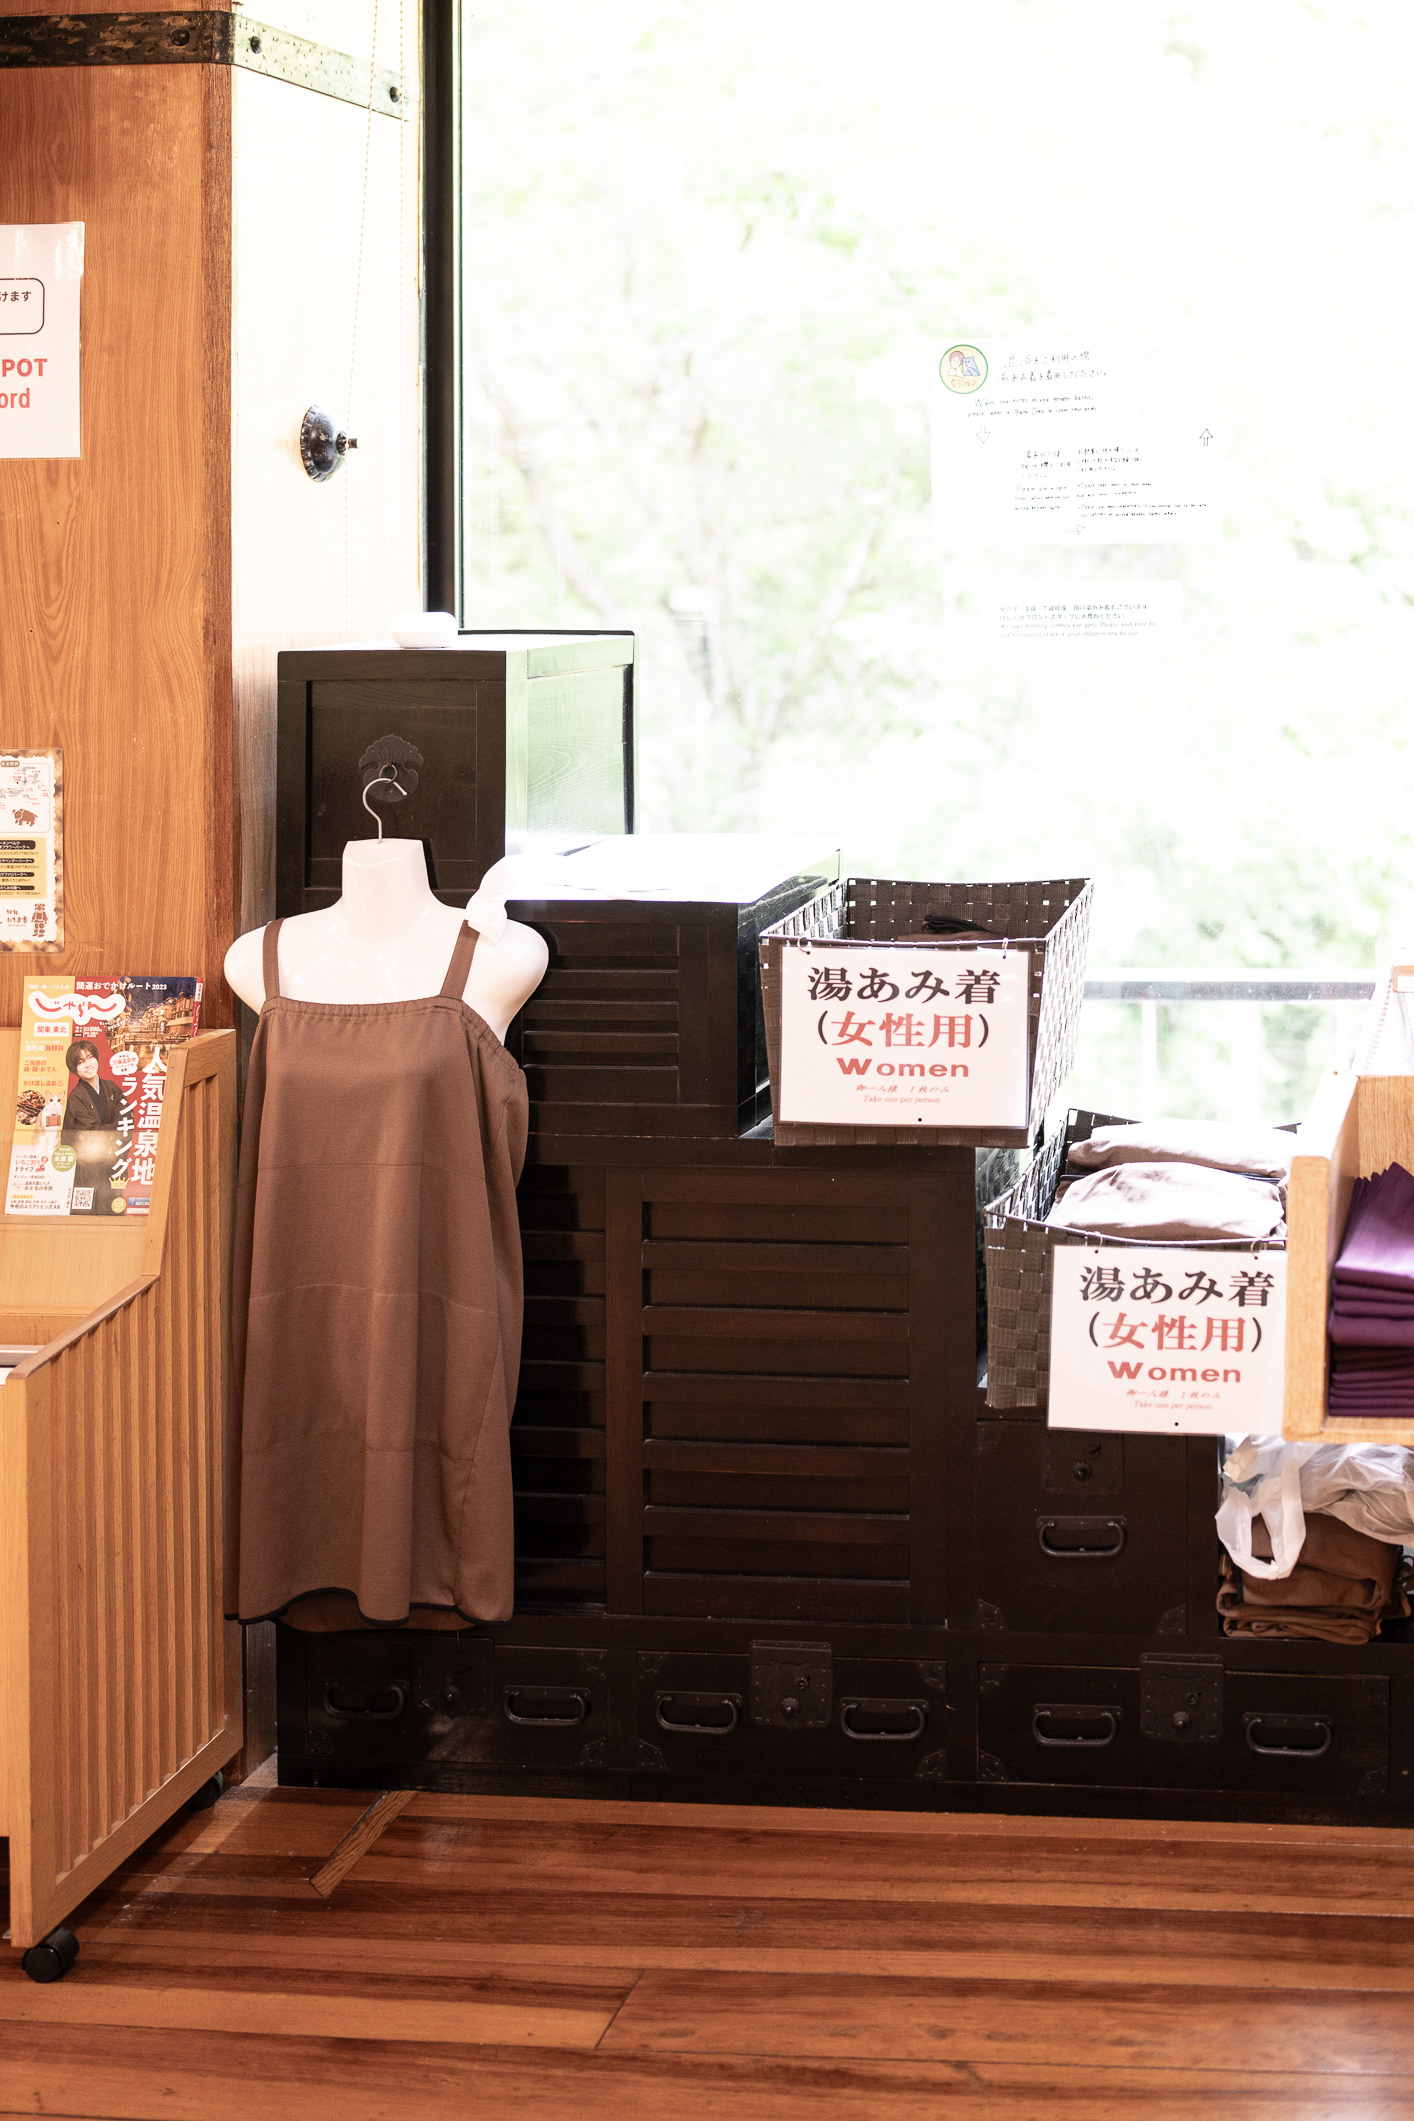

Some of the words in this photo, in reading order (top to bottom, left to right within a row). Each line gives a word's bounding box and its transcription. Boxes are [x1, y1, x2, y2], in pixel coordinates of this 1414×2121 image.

[807, 967, 1001, 1005] 湯あみ着
[37, 1025, 51, 1034] 関東
[52, 1025, 67, 1034] 東北
[818, 1010, 989, 1048] (女性用)
[836, 1057, 968, 1077] Women
[863, 1094, 883, 1103] Take
[899, 1096, 913, 1105] per
[111, 1076, 138, 1179] ランキング
[1079, 1266, 1275, 1307] 湯あみ着
[1089, 1312, 1262, 1353] (女性用)
[1107, 1361, 1241, 1383] Women
[1134, 1400, 1153, 1408] Take
[1154, 1401, 1170, 1409] one
[1170, 1402, 1184, 1410] per
